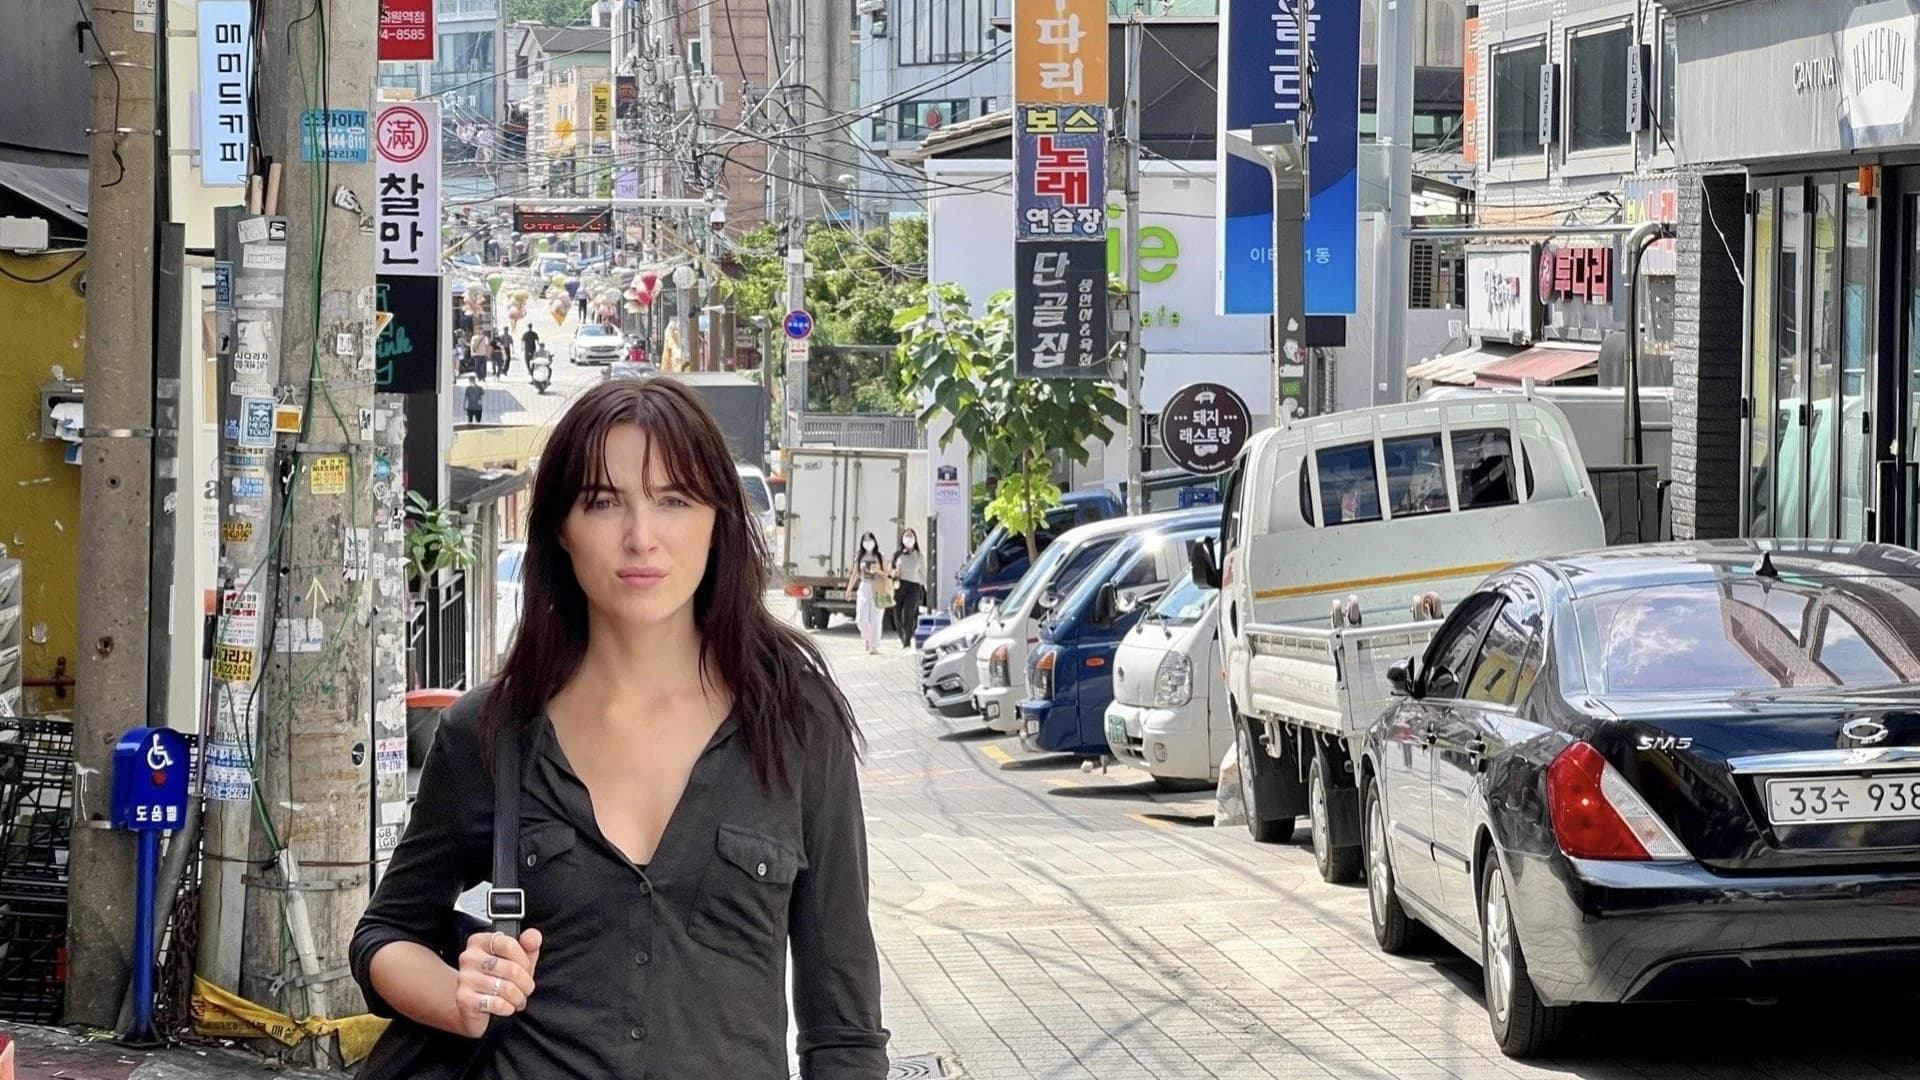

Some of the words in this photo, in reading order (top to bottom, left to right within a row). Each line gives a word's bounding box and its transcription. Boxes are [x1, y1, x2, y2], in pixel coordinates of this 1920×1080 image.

[1035, 0, 1087, 96] 다리
[1853, 27, 1906, 96] HACIENDA
[1792, 56, 1838, 92] CANTINA
[1025, 108, 1099, 134] 보스
[1034, 135, 1090, 207] 노래
[1025, 207, 1102, 235] 연습장
[1031, 252, 1070, 369] 단골집
[1192, 408, 1219, 426] 돼지
[1636, 735, 1694, 751] SM5
[136, 804, 178, 821] 도움벨
[1788, 786, 1851, 816] 33수
[1867, 782, 1920, 812] 938
